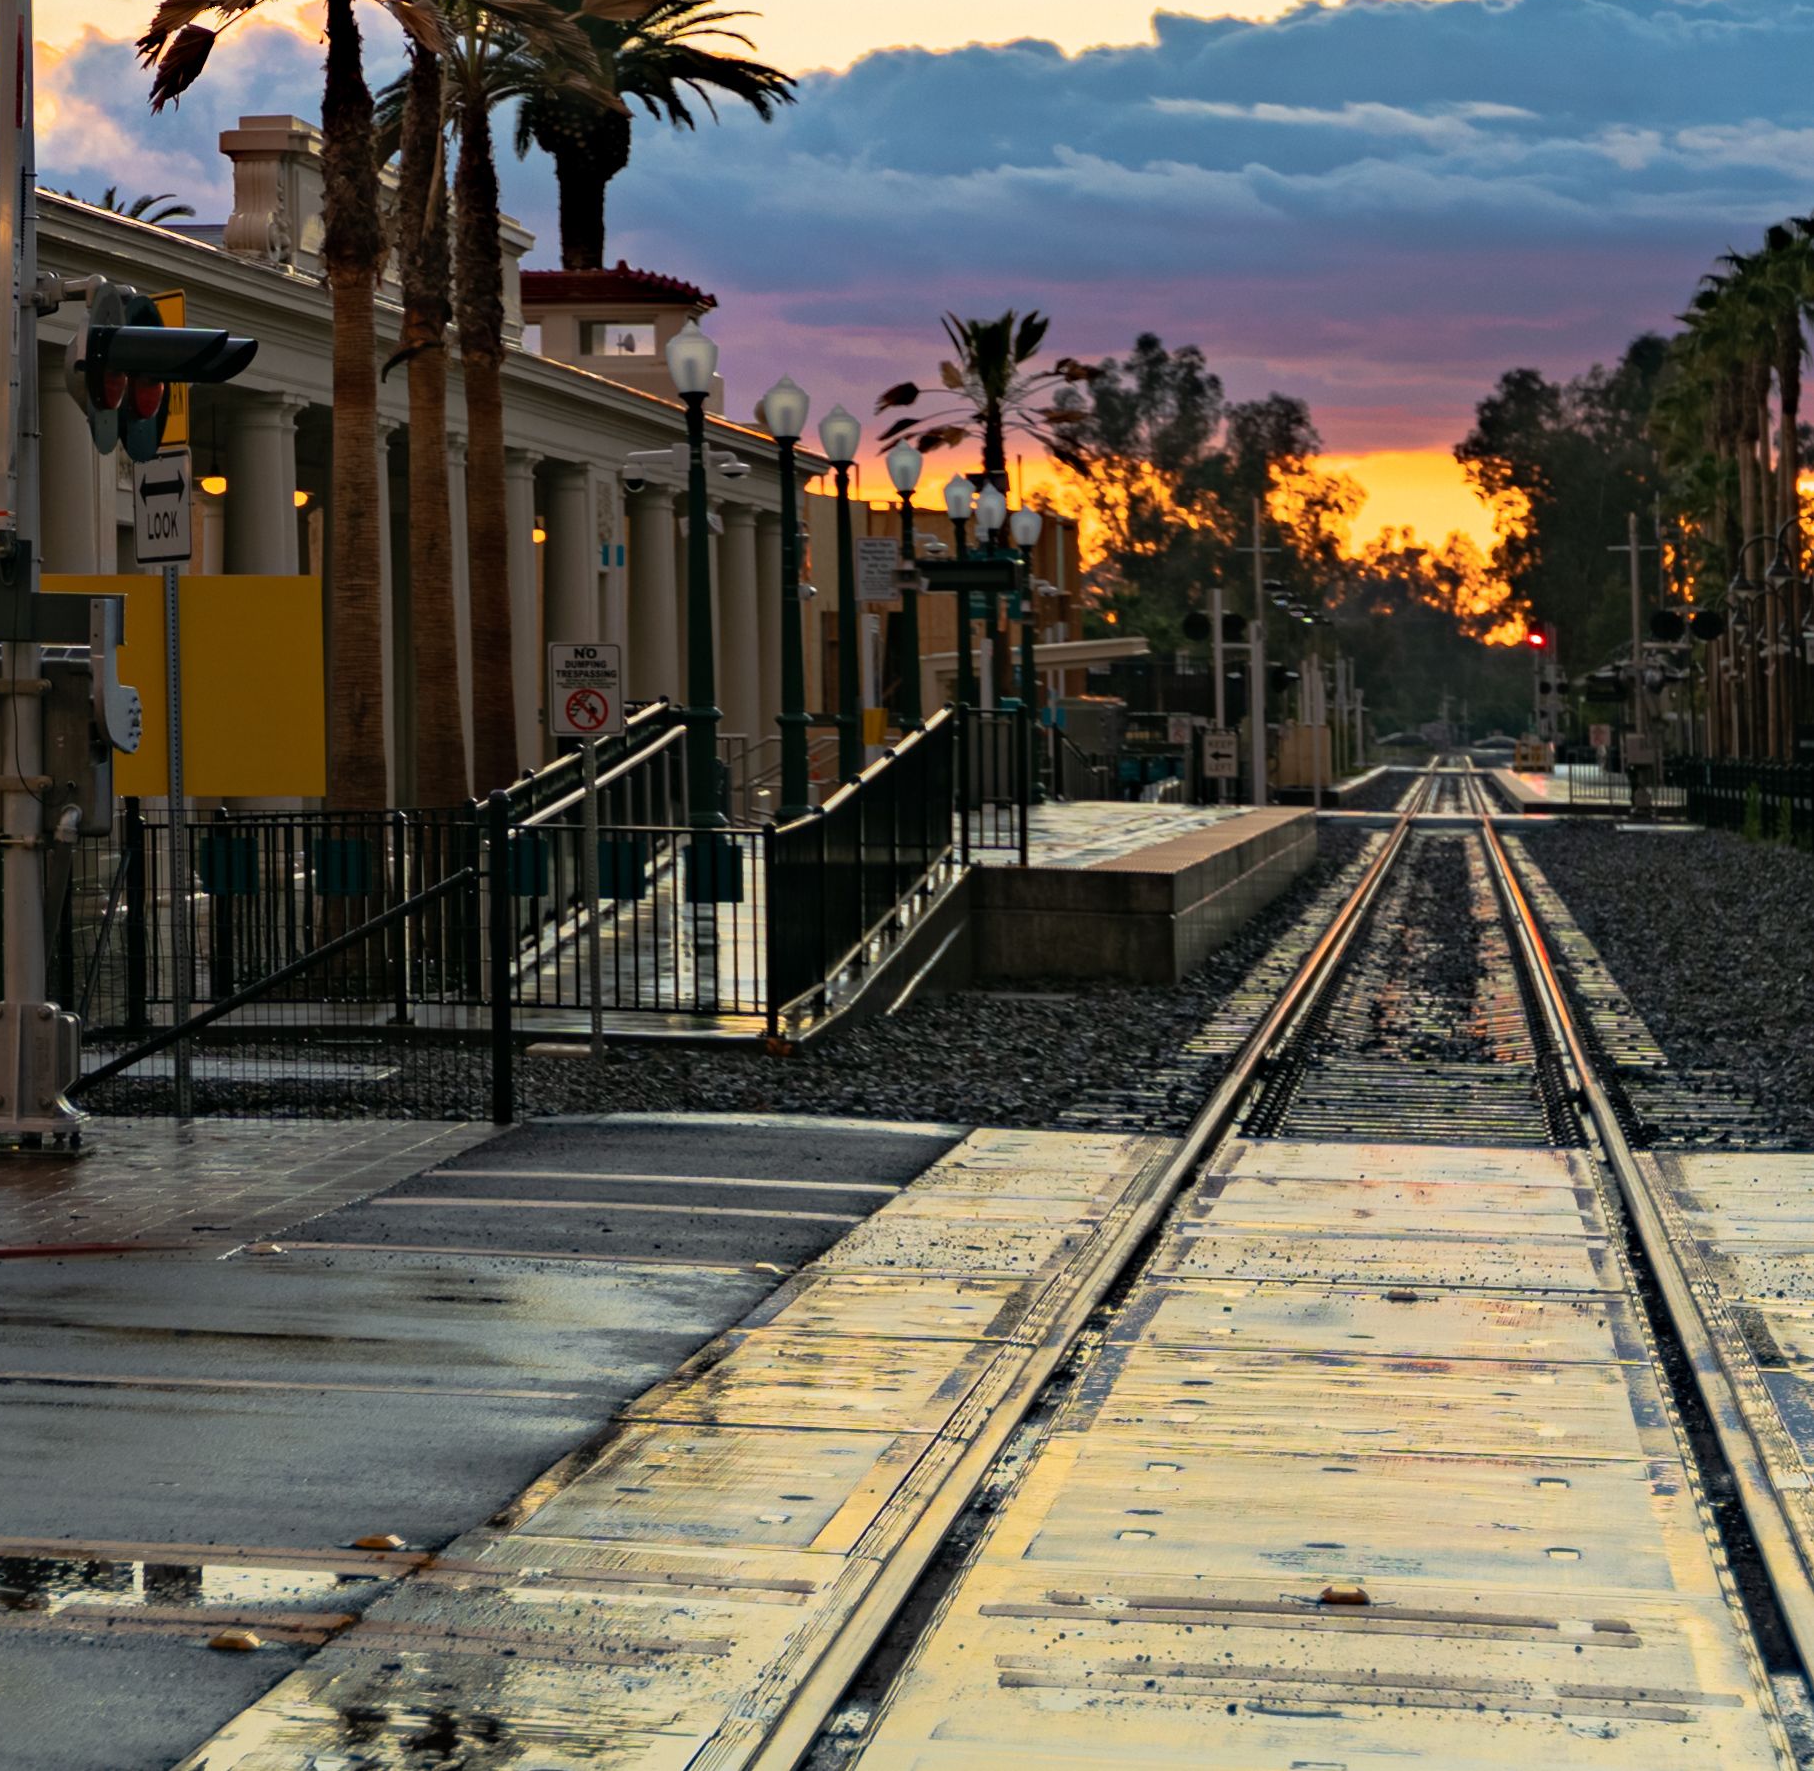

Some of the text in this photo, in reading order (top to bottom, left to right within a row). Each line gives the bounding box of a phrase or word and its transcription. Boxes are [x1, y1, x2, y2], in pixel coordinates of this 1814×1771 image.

[147, 511, 179, 540] LOOK
[573, 648, 598, 659] NO
[564, 660, 607, 668] DUMPING
[556, 670, 617, 678] TRESPASSING
